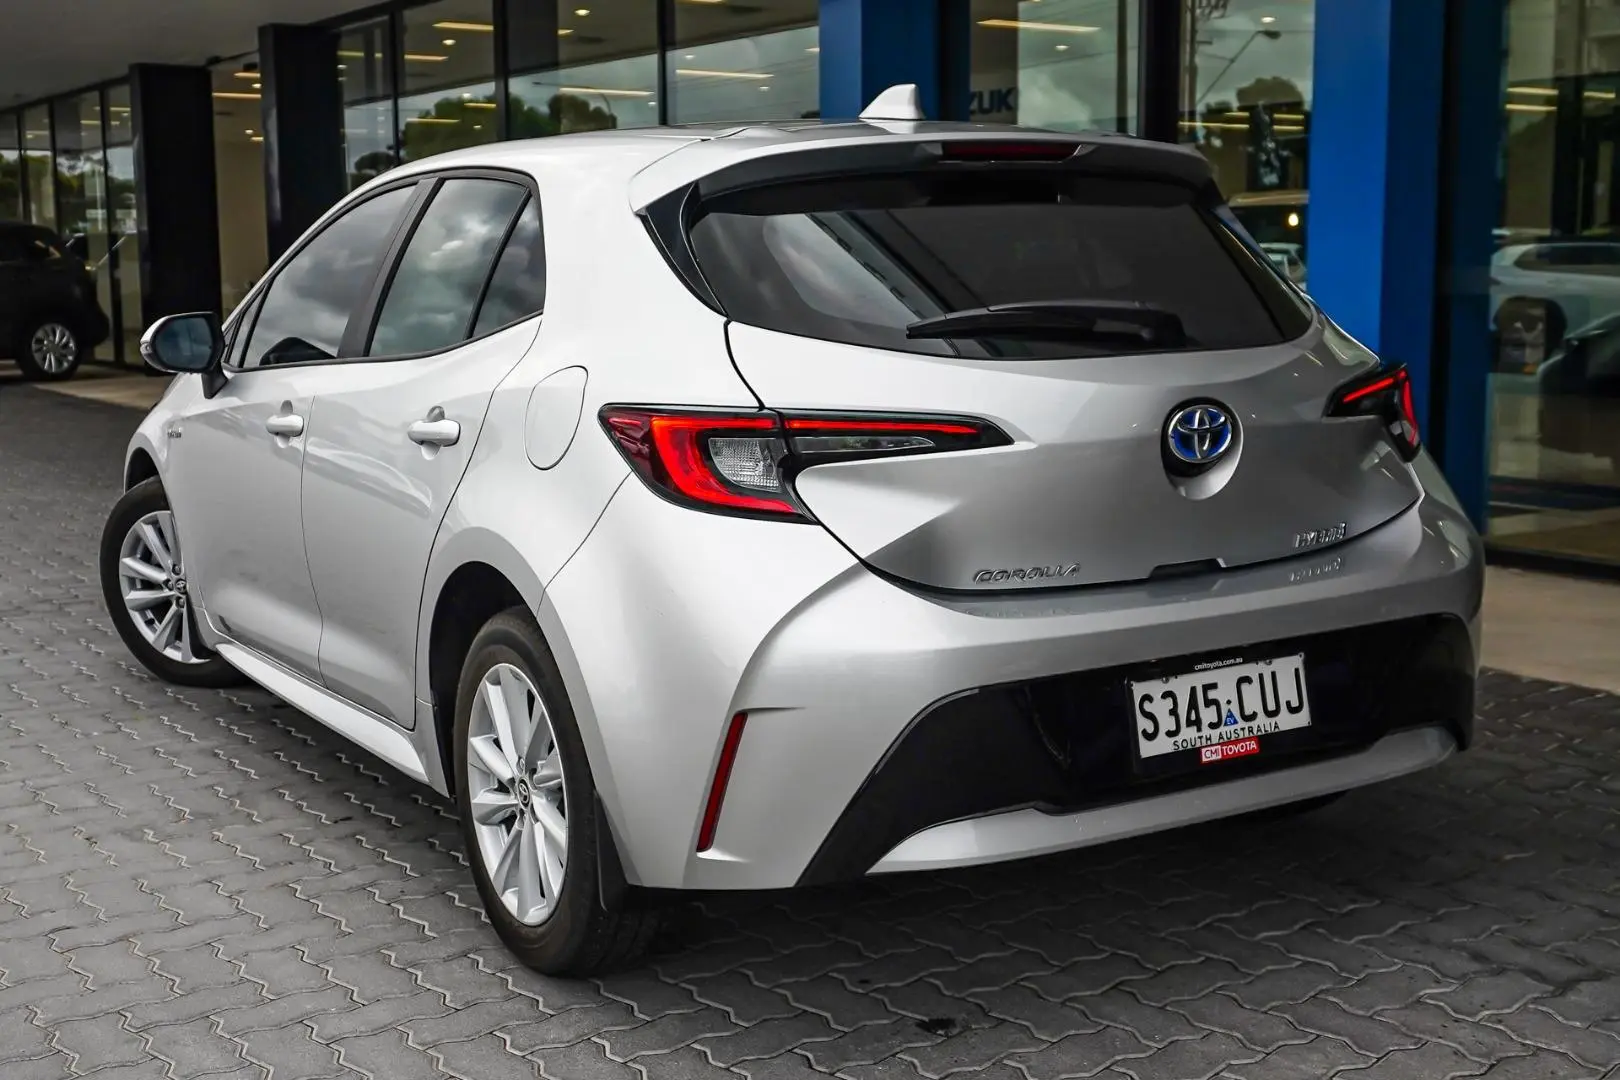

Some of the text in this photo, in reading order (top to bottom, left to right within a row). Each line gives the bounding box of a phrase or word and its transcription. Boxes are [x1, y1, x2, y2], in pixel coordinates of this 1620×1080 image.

[973, 562, 1080, 584] COROLLA
[1194, 657, 1243, 670] cmitoyota.com.au
[1138, 667, 1305, 741] S345 CUJ
[1173, 721, 1281, 751] SOUTH AUSTRALIA
[1203, 740, 1258, 760] CMI TOYOTA
